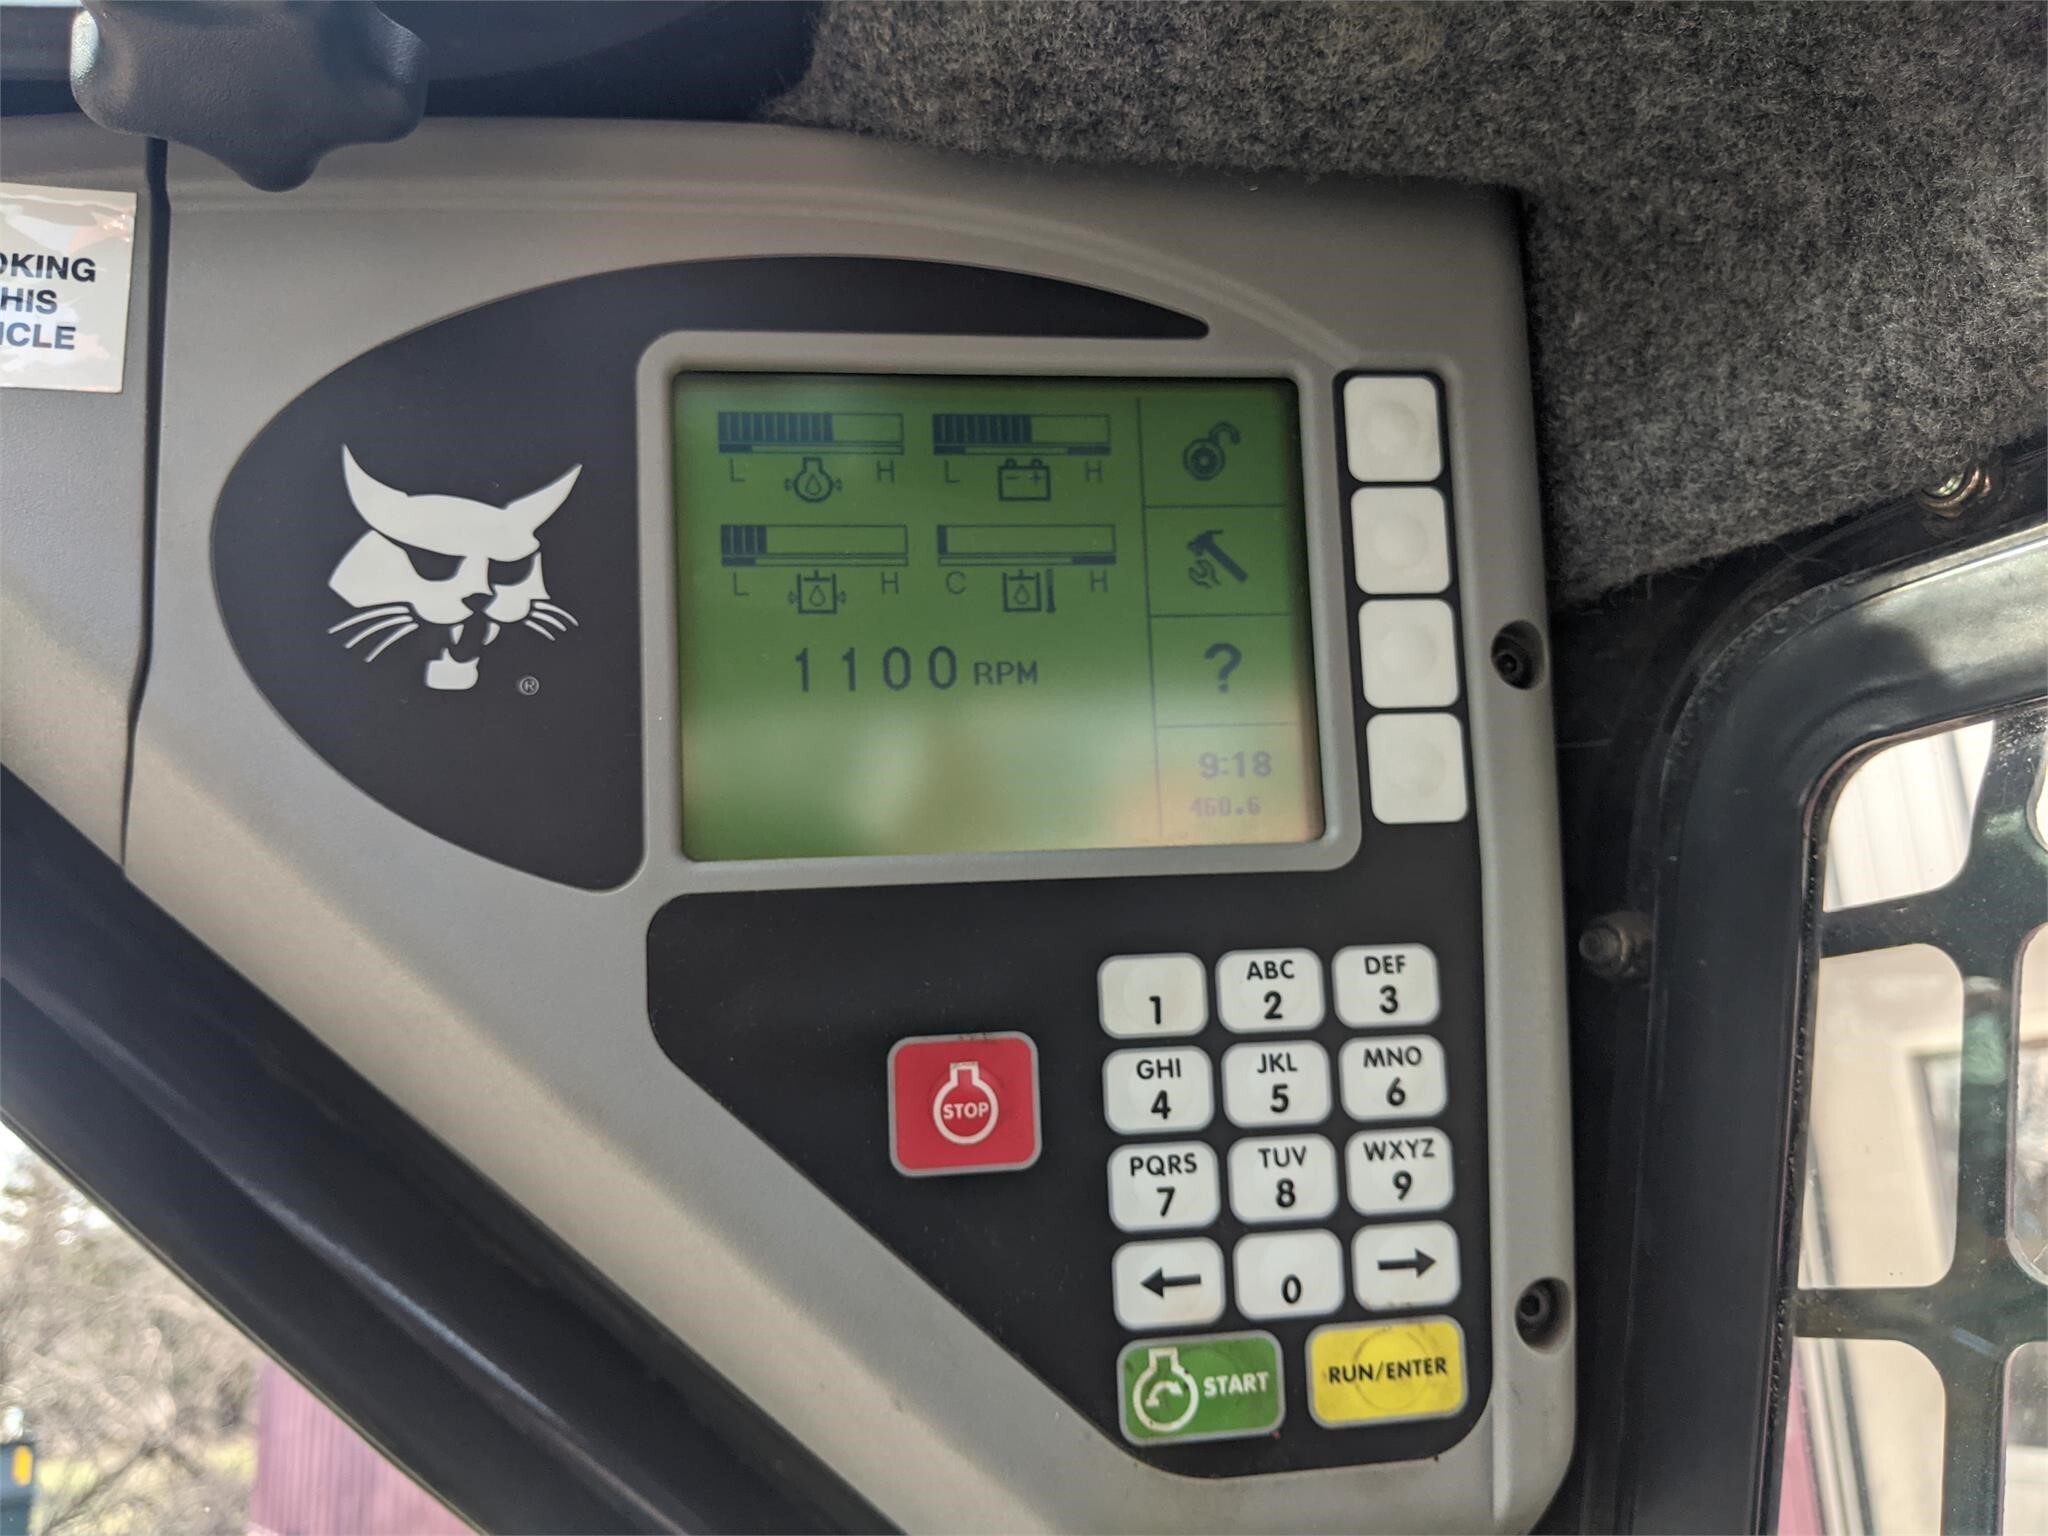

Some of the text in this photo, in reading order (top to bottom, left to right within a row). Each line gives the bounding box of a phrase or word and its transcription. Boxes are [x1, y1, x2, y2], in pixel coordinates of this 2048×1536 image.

[730, 459, 895, 483] L H
[944, 459, 1104, 484] L H
[733, 570, 900, 596] L H
[945, 568, 1109, 595] C H
[795, 645, 1039, 692] 1100 RPM
[1199, 751, 1273, 779] 9:18
[1246, 959, 1296, 982] ABC
[1364, 954, 1406, 976] DEF
[1149, 995, 1163, 1026] 1
[1263, 990, 1284, 1021] 2
[1379, 984, 1399, 1015] 3
[1136, 1057, 1182, 1081] GHI
[1256, 1052, 1298, 1074] JKL
[1362, 1045, 1423, 1068] MNO
[1150, 1089, 1171, 1120] 4
[1269, 1083, 1290, 1114] 5
[1385, 1076, 1407, 1107] 6
[942, 1101, 990, 1120] STOP
[1257, 1145, 1308, 1169] TUV
[1363, 1137, 1436, 1162] WXYZ
[1129, 1152, 1198, 1177] PQRS
[1275, 1178, 1296, 1209] 8
[1391, 1169, 1413, 1201] 9
[1156, 1186, 1176, 1217] 7
[1281, 1274, 1303, 1304] 0
[1202, 1370, 1271, 1398] START
[1327, 1355, 1448, 1385] RUN/ENTER
